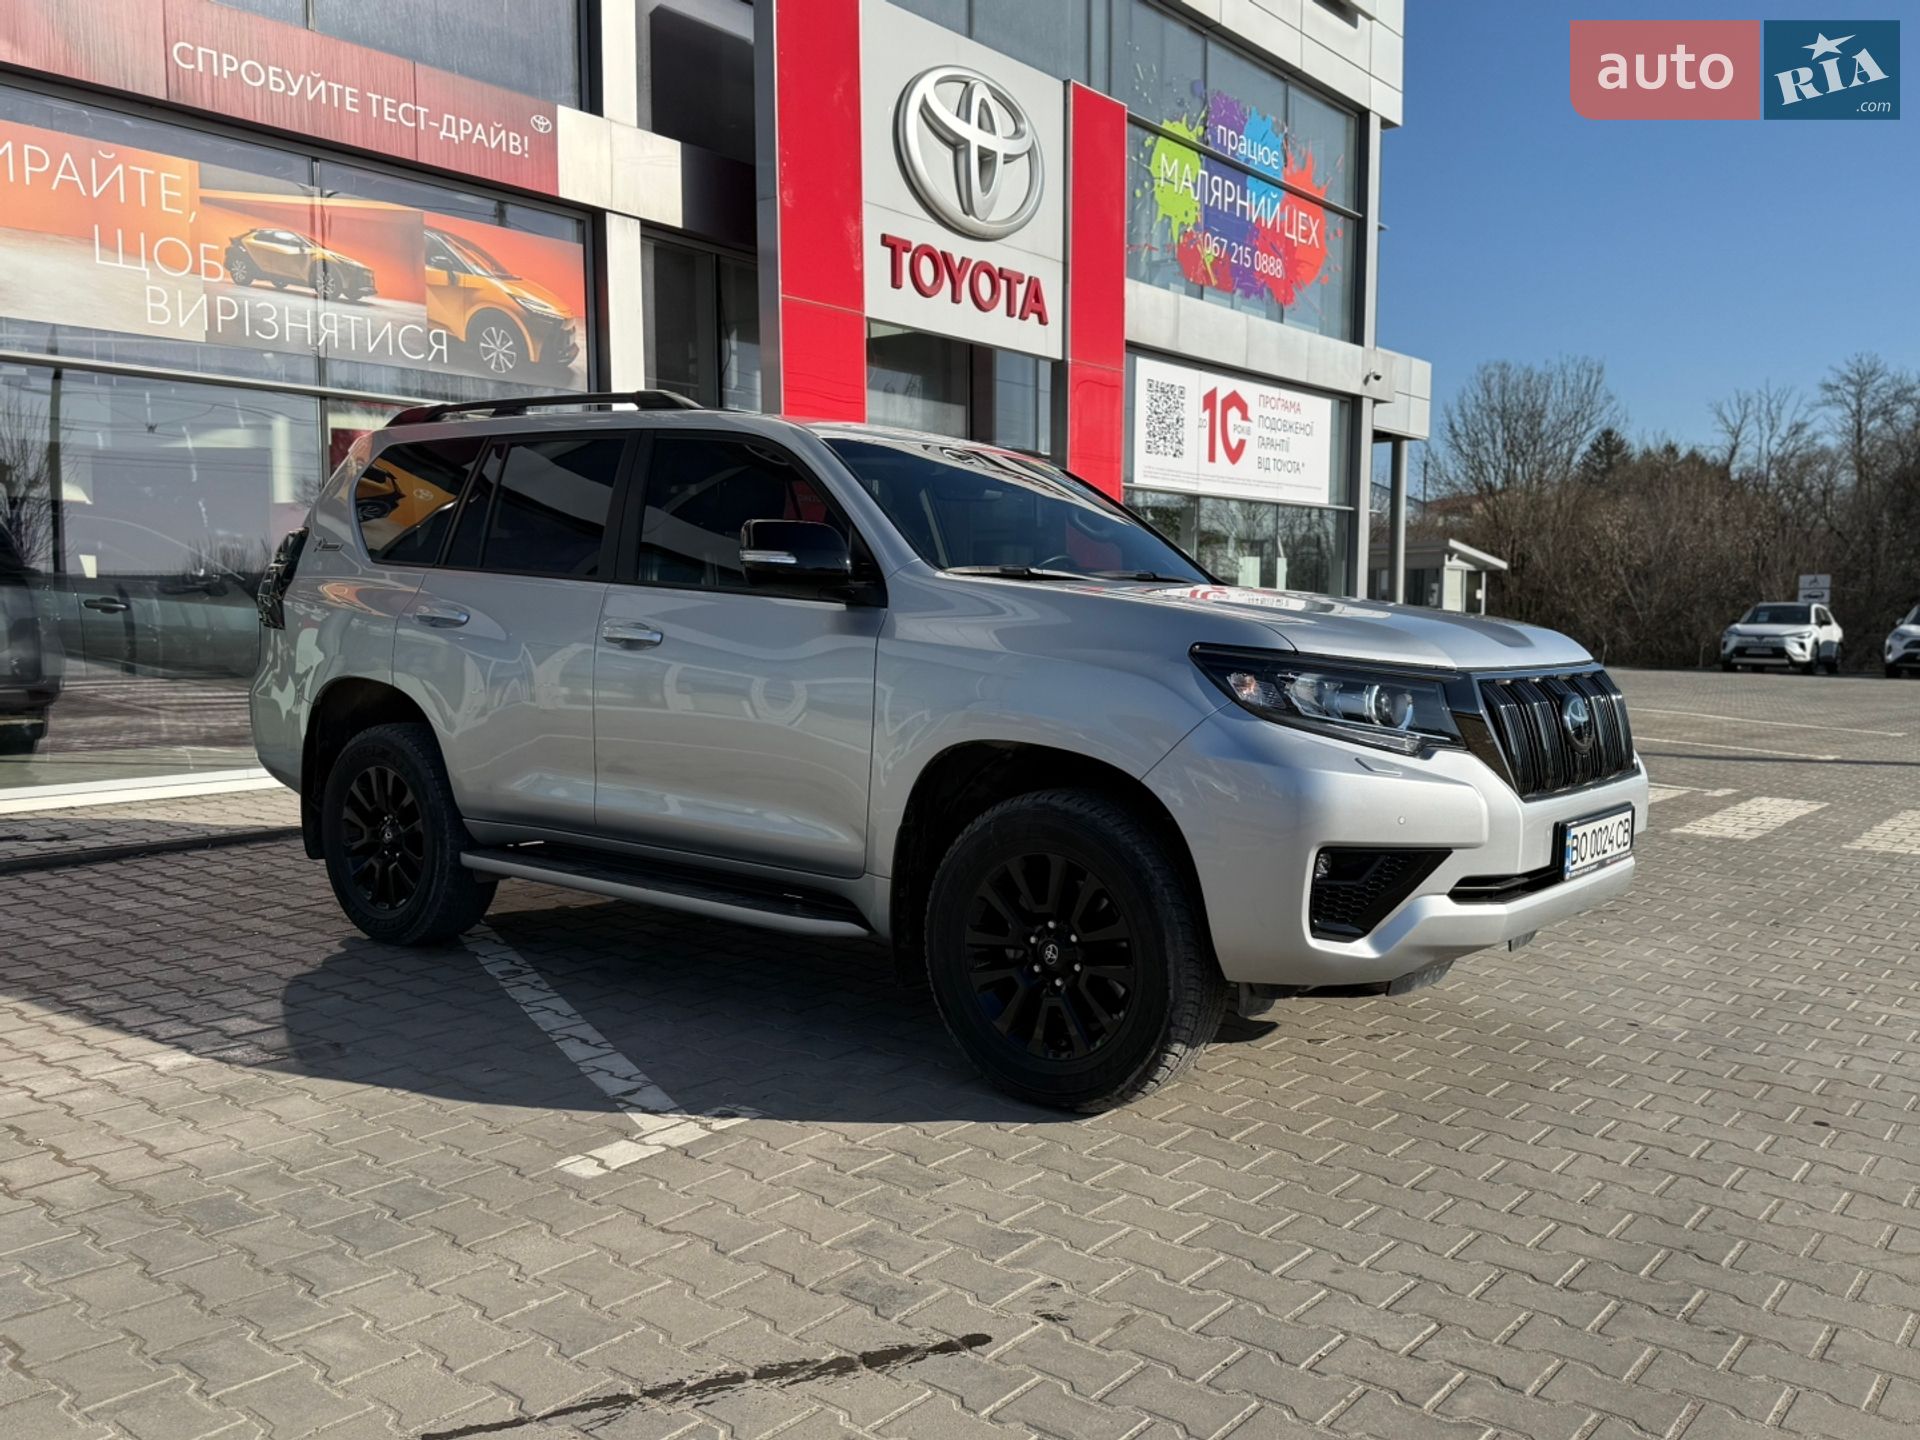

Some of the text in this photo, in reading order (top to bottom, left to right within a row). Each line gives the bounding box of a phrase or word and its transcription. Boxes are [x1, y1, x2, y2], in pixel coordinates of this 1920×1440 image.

[172, 41, 530, 159] СПРОБУЙТЕ ТЕСТ-ДРАЙВ!
[1216, 124, 1280, 170] працює
[1160, 152, 1321, 249] МАЛЯРНИЙ ЦЕХ
[94, 223, 225, 283] ЩОБ
[1204, 233, 1283, 279] 067 215 0888
[880, 233, 1049, 326] TOYOTA
[145, 285, 449, 364] ВИРІЗНЯТИСЯ
[1258, 394, 1302, 415] ПРОГРАМА
[1258, 414, 1315, 437] ПОДОВЖЕНОЇ
[1257, 435, 1291, 453] ГАРАНТІЇ
[1257, 456, 1271, 473] ВІД
[1571, 832, 1588, 866] BO
[1590, 822, 1615, 859] 0024
[1616, 818, 1630, 848] CB
